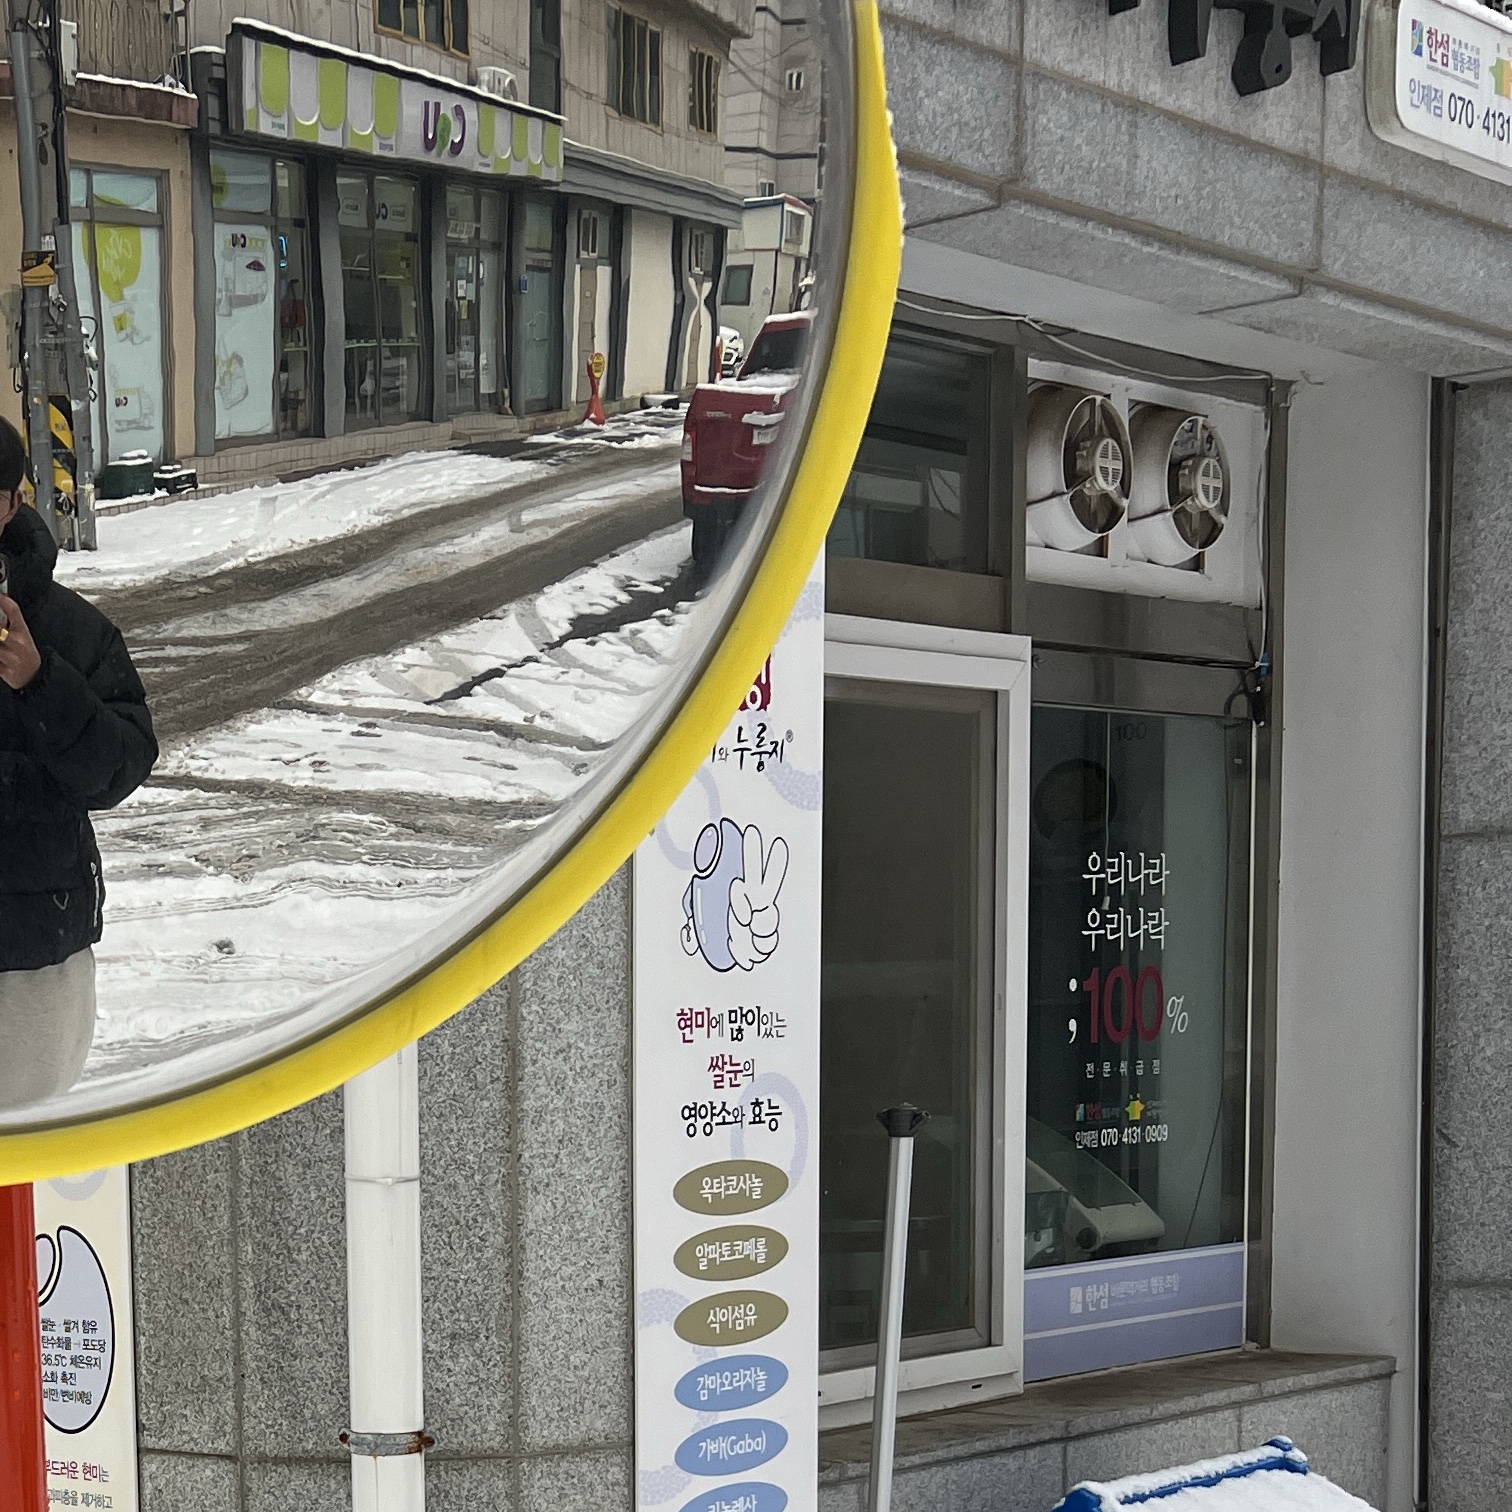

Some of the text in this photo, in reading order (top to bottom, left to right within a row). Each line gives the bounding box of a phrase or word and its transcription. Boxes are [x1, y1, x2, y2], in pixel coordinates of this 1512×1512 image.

[1426, 26, 1450, 68] 한섬
[1409, 78, 1444, 118] 인제점
[732, 722, 785, 773] 누룽지
[1081, 851, 1171, 897] 우리나라
[1081, 907, 1170, 952] 우리나락
[676, 1007, 724, 1043] 현미에
[707, 1053, 755, 1089] 쌀눈의
[681, 1097, 783, 1138] 영양소와 효능
[699, 1172, 764, 1204] 옥타코사놀
[695, 1237, 768, 1271] 알파토코페롤
[1086, 1282, 1109, 1312] 한섬
[706, 1303, 758, 1335] 식이섬유
[69, 1354, 102, 1371] 체온유지
[82, 1338, 107, 1353] 포도당
[42, 1370, 78, 1386] 소화 촉진
[696, 1366, 768, 1401] 감마오리자놀
[698, 1430, 767, 1462] 가배(Gaba)
[81, 1461, 110, 1483] 현미는
